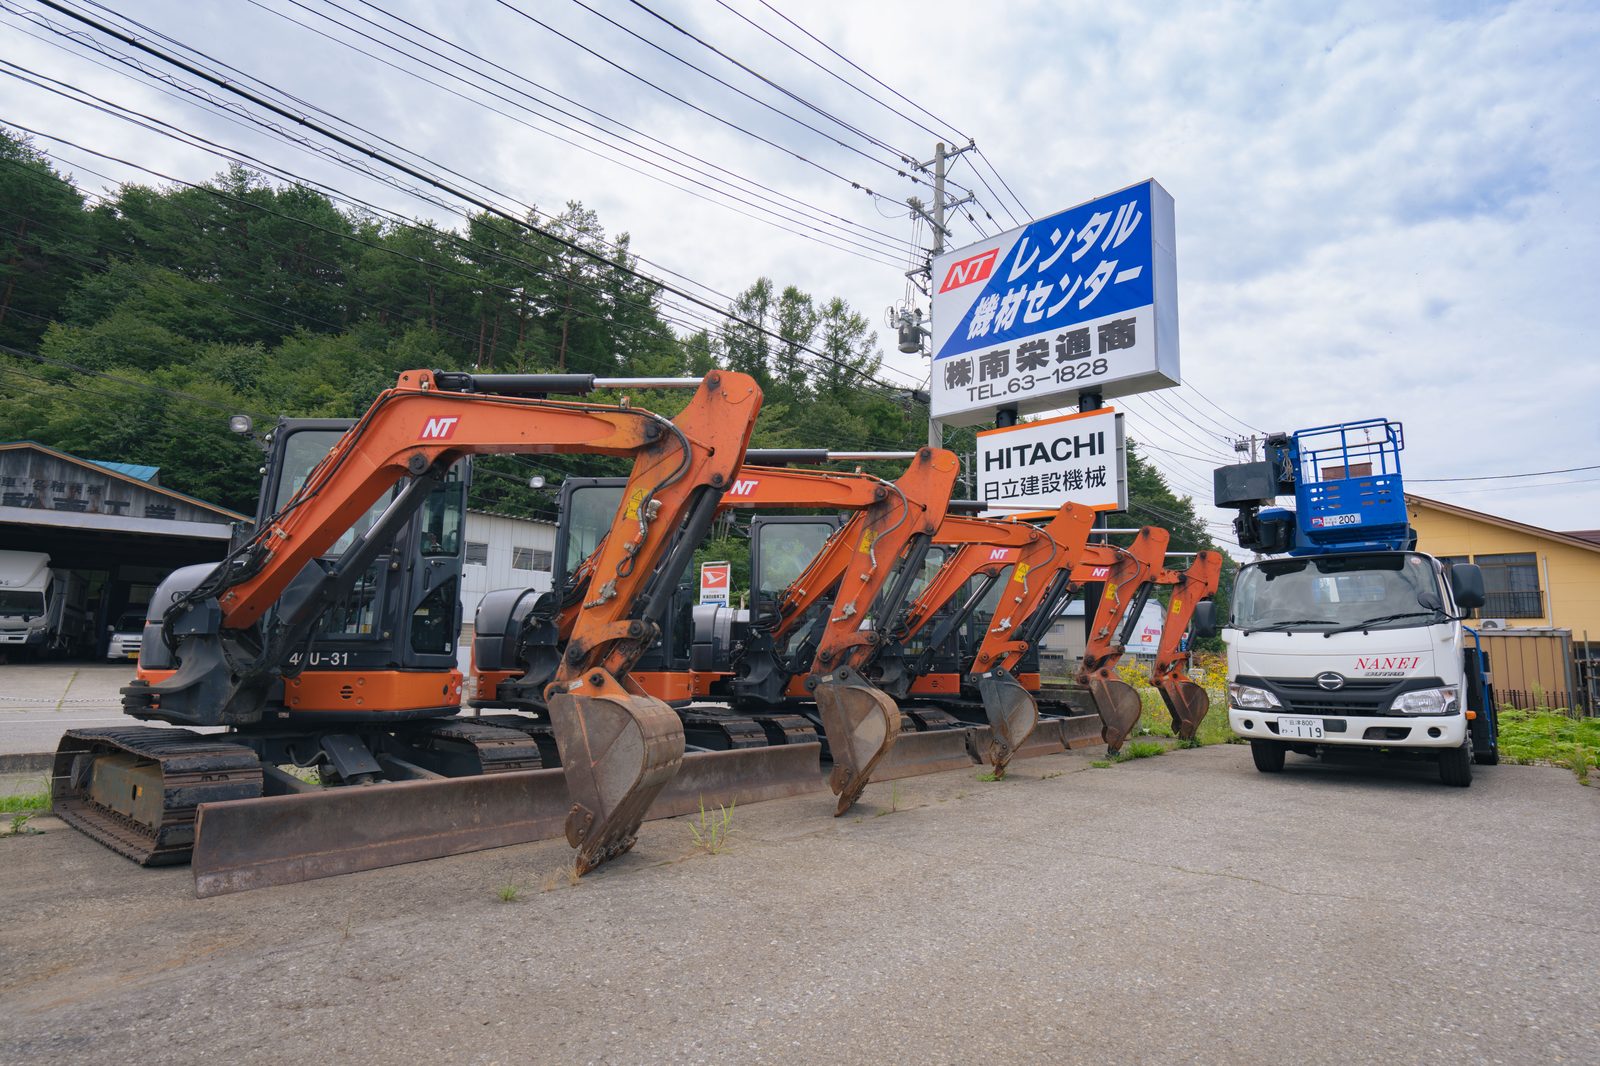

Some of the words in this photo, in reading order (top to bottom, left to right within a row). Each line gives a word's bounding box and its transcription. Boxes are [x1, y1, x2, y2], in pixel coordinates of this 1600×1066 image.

[1007, 200, 1143, 283] レンタル
[946, 253, 995, 289] NT
[966, 259, 1144, 341] 機材センター
[944, 317, 1137, 391] (株)南栄通商
[422, 417, 458, 438] NT
[985, 431, 1105, 472] HITACHI
[730, 479, 759, 496] NT
[984, 465, 1107, 501] 日立建設機械
[1338, 515, 1356, 525] 200
[989, 549, 1009, 560] NT
[1092, 568, 1110, 577] NT
[1354, 657, 1420, 670] NANEI
